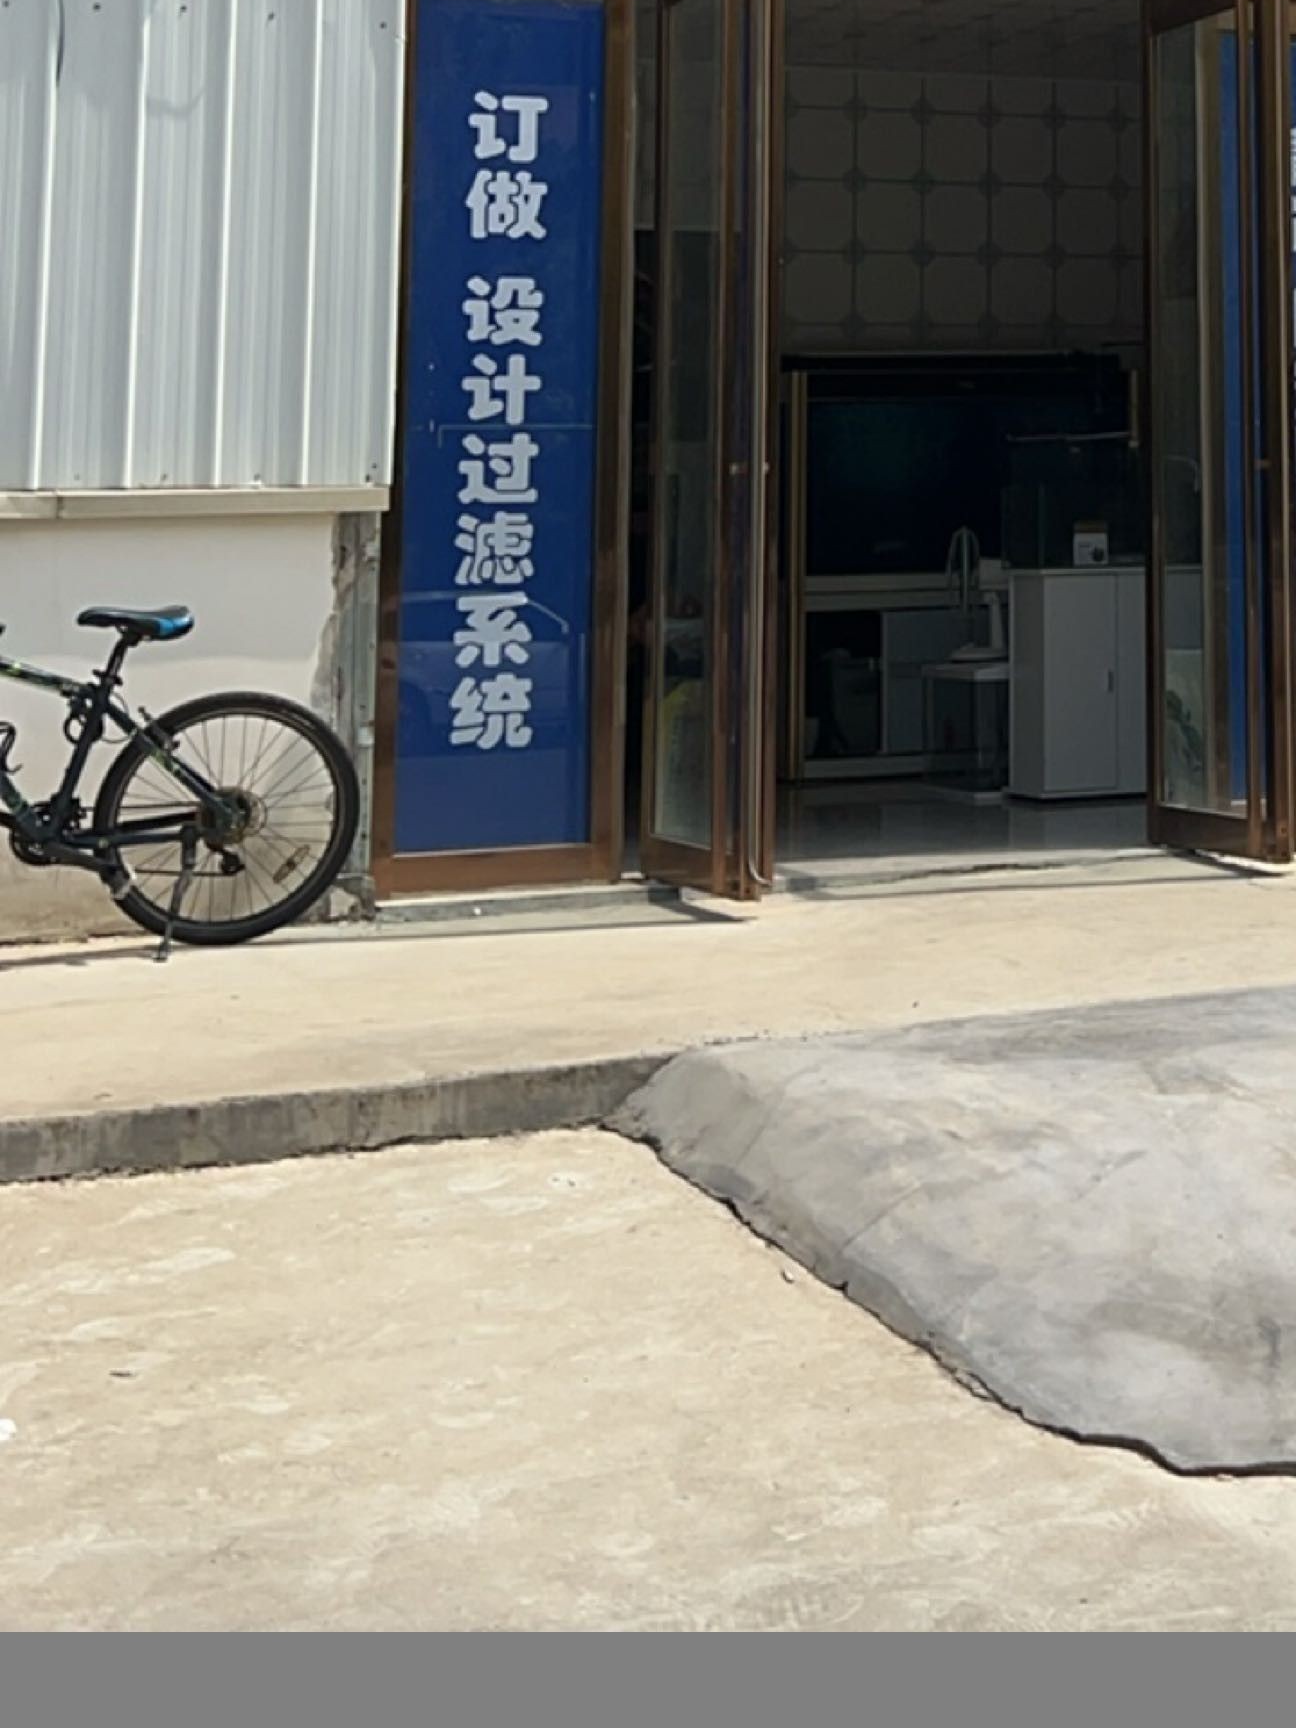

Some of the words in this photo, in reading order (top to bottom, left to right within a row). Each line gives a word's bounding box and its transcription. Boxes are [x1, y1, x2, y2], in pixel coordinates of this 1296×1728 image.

[465, 90, 549, 239] 订做
[449, 275, 544, 750] 设计过滤系统
